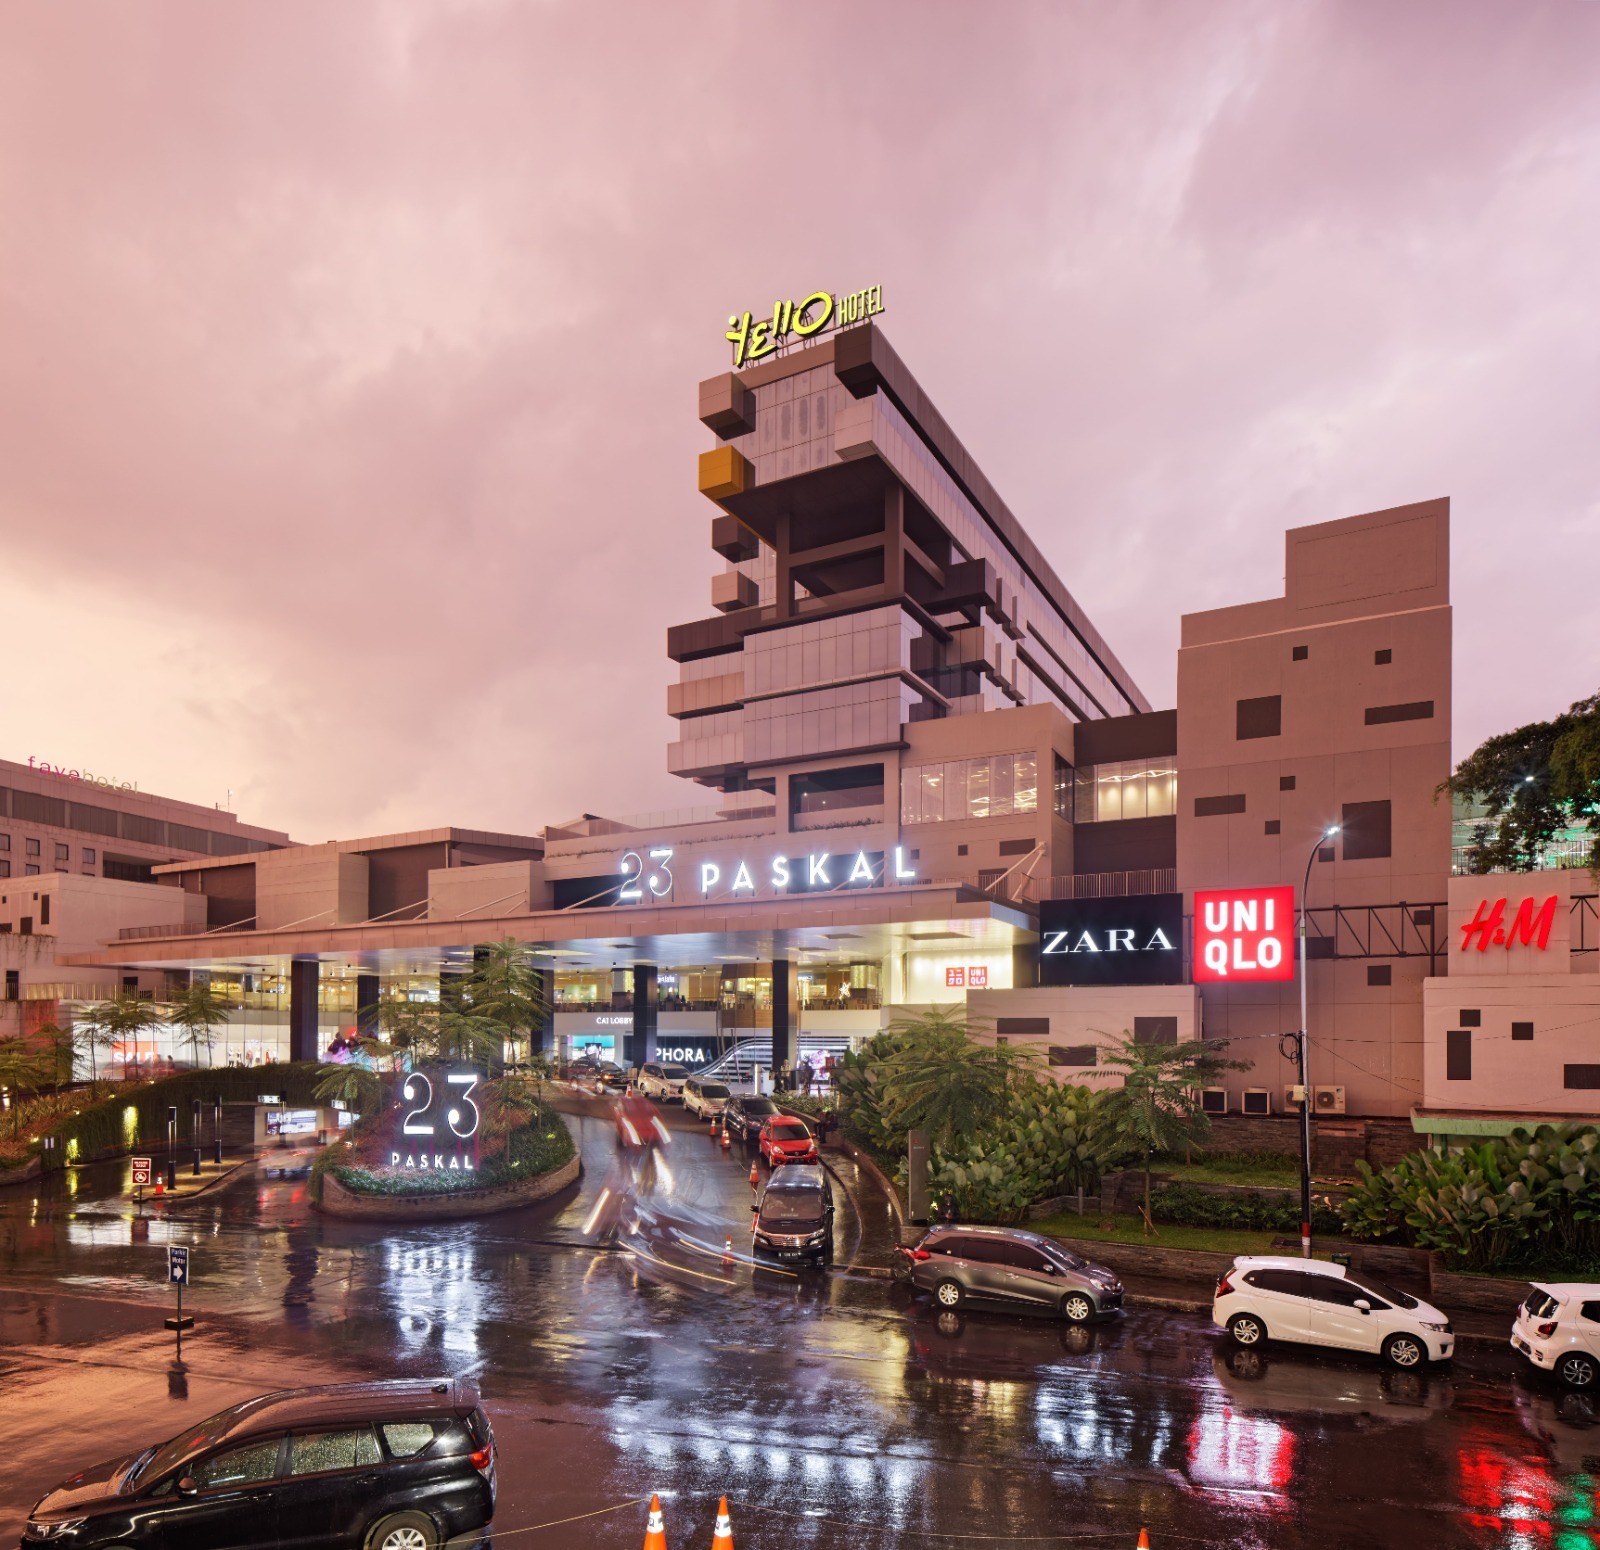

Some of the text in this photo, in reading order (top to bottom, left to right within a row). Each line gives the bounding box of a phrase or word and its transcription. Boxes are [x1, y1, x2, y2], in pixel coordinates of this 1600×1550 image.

[838, 284, 885, 325] HOTEL
[27, 755, 139, 794] favehotel
[619, 846, 915, 899] 23 PASKAL
[1204, 898, 1275, 932] UNI
[1460, 895, 1559, 952] H&M
[1041, 927, 1178, 955] ZARA
[1204, 936, 1282, 976] QLO
[655, 1047, 705, 1062] PHORA
[403, 1072, 479, 1138] 23
[391, 1152, 473, 1169] PASKAL
